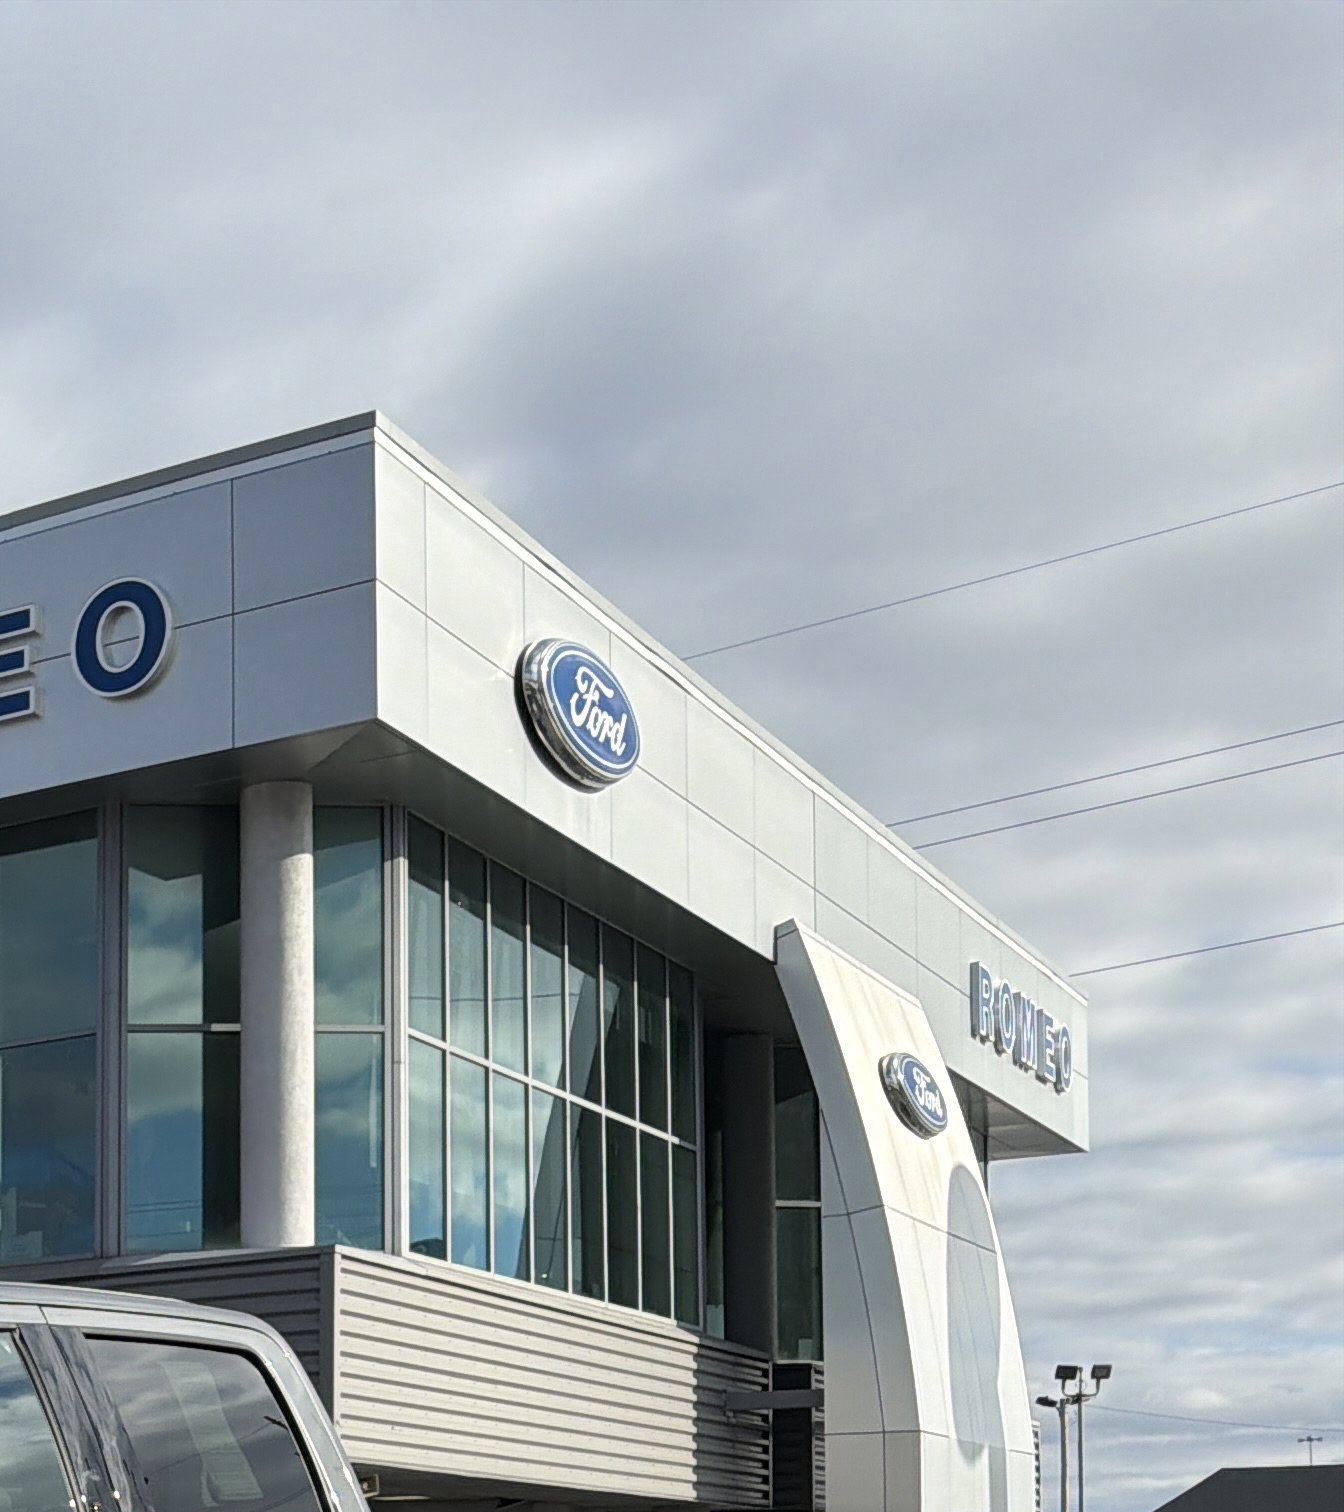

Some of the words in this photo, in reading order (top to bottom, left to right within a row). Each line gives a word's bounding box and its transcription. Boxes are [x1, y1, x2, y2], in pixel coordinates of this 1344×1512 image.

[569, 666, 628, 757] Ford
[969, 961, 1073, 1094] ROMEO
[913, 1068, 943, 1118] Ford
